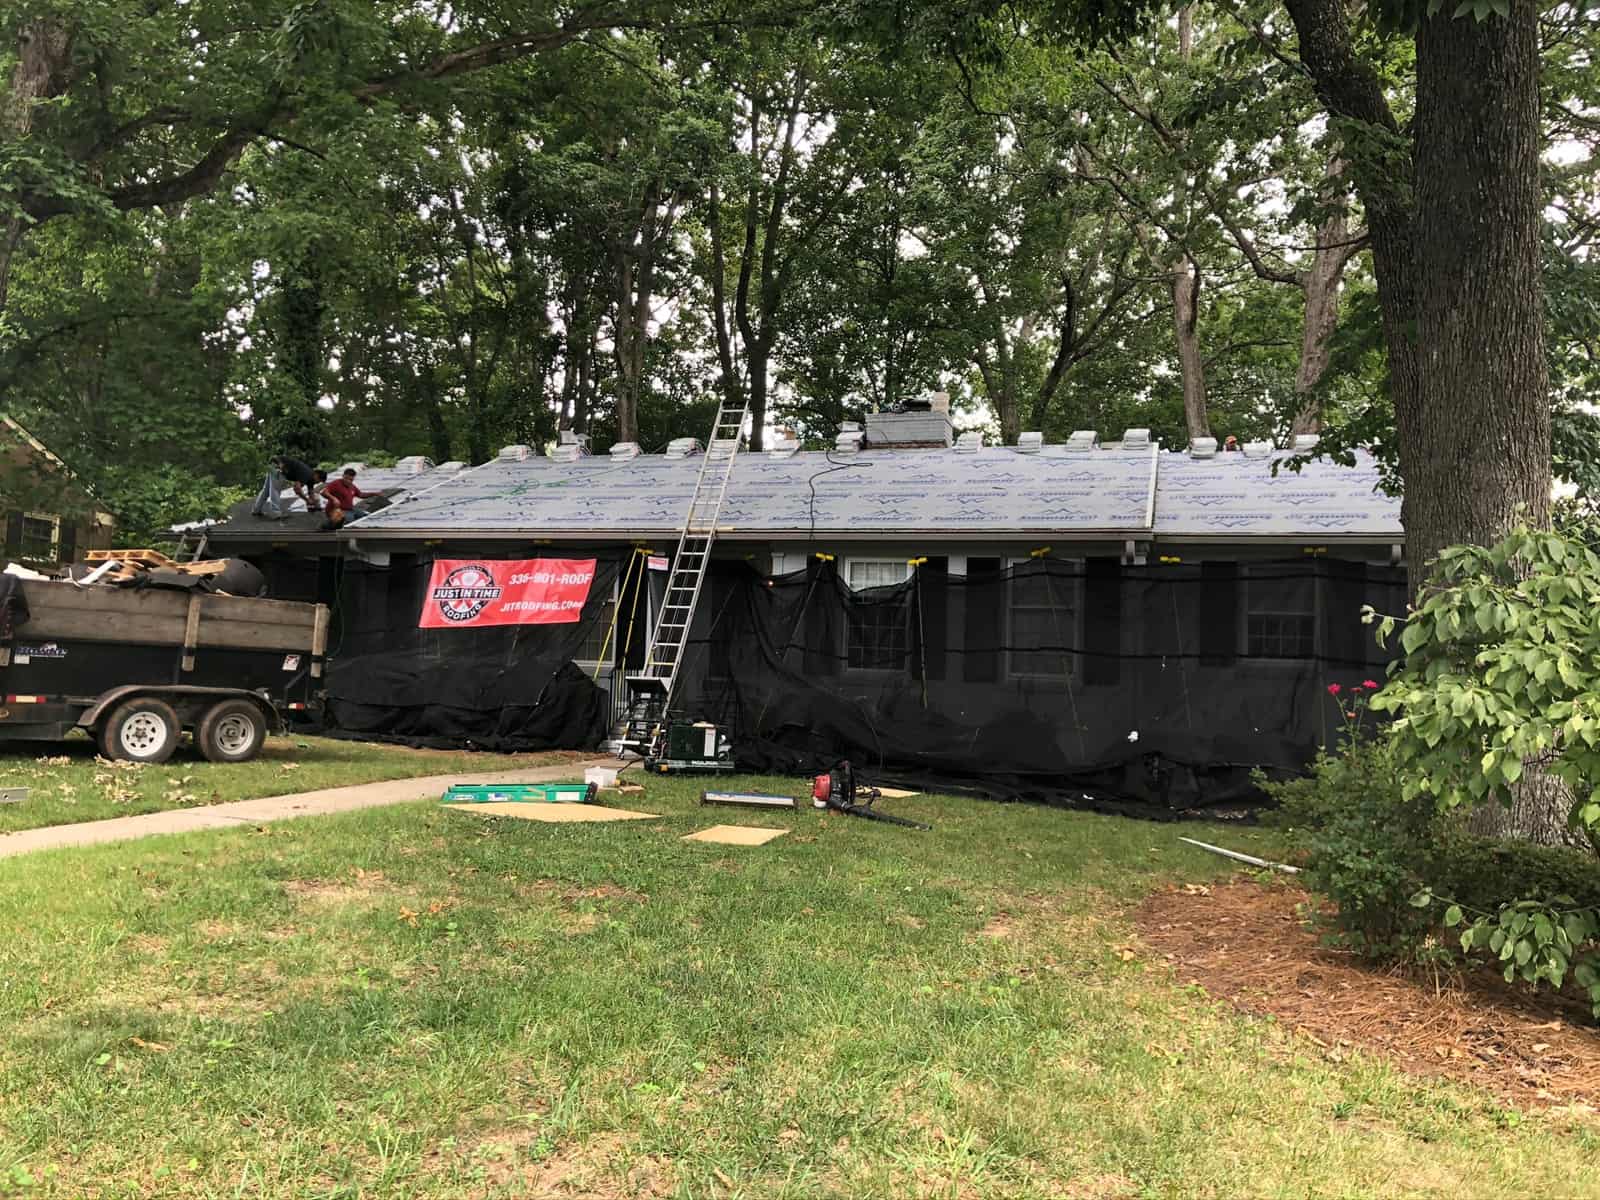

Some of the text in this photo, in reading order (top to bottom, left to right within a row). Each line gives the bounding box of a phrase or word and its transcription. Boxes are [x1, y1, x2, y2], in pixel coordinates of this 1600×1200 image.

[434, 589, 499, 598] JUST IN TIME
[443, 603, 482, 620] ROOFING
